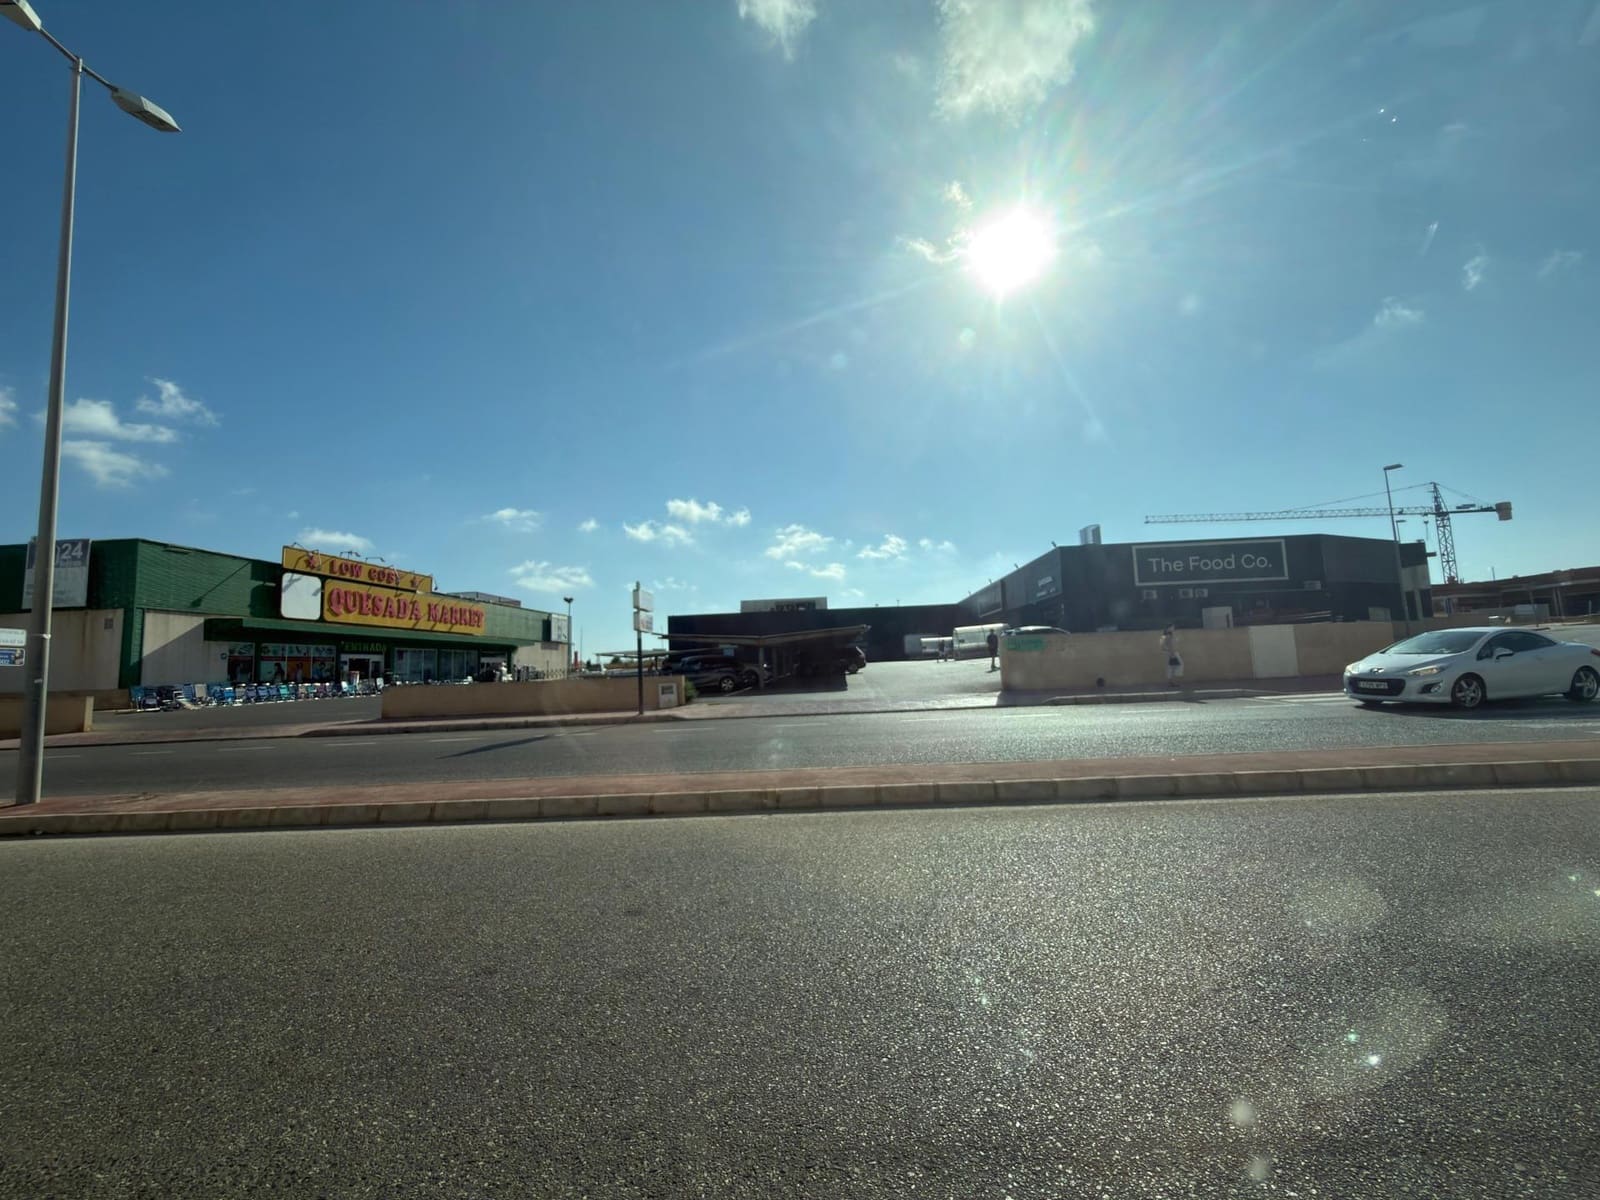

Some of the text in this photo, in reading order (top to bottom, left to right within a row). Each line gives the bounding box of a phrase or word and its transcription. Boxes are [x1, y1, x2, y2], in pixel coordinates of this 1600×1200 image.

[330, 560, 362, 577] LOW
[1148, 553, 1273, 573] The Food Co.
[329, 588, 484, 627] QUESADA MARKET
